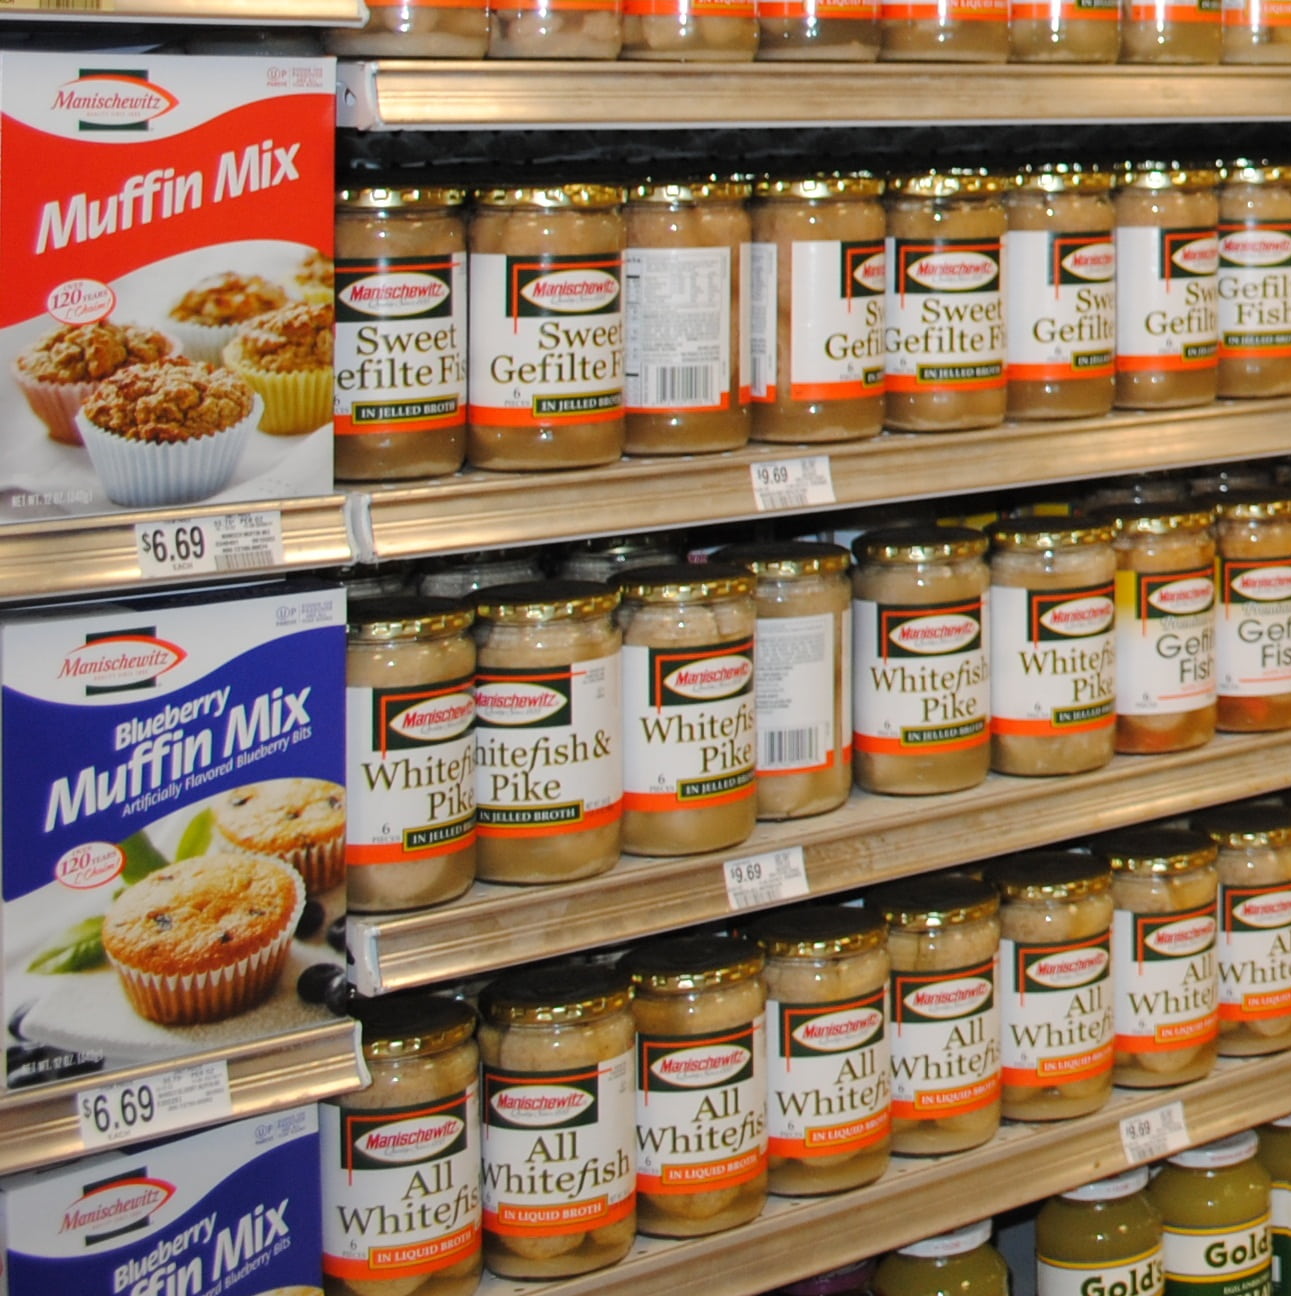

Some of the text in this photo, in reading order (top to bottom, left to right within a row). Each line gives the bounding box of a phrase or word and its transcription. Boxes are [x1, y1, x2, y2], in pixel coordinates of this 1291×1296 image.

[50, 90, 163, 113] Manischewitz
[35, 138, 302, 256] Muffin Mix
[52, 288, 82, 310] 120
[350, 282, 445, 301] Manischewitz
[532, 278, 616, 296] Manischewitz
[921, 297, 1003, 325] Sweet
[356, 323, 458, 357] Sweet
[538, 320, 624, 351] Sweet
[886, 326, 985, 355] Gefilte
[334, 356, 431, 392] efilte
[490, 352, 609, 385] Gefilte
[361, 399, 456, 418] IN JELLED BROTH
[541, 396, 598, 412] IN JELLED
[757, 465, 789, 486] $9.69
[141, 526, 206, 564] $6.69
[57, 650, 170, 678] Manischewitz
[1071, 671, 1115, 703] Pike
[114, 686, 232, 751] Blueberry
[921, 695, 978, 724] Pike
[43, 686, 313, 833] Muffin Mix
[121, 726, 313, 819] Artificially Flavored Blueberry Bits
[700, 739, 753, 776] Pike
[427, 783, 475, 822] Pike
[490, 771, 562, 803] Pike
[686, 782, 700, 795] IN
[492, 808, 533, 825] JELLED
[534, 806, 577, 822] BROTH
[412, 832, 426, 845] IN
[60, 852, 92, 877] 120
[731, 862, 762, 884] $9.69
[1182, 958, 1214, 987] All
[1066, 988, 1102, 1019] All
[943, 1018, 984, 1052] All
[661, 1049, 744, 1073] Manischewitz
[834, 1050, 877, 1085] All
[83, 1083, 155, 1133] $6.69
[497, 1092, 587, 1111] Manischewitz
[691, 1088, 741, 1124] All
[922, 1093, 934, 1104] IN
[366, 1120, 459, 1151] Manischewitz
[526, 1131, 578, 1163] All
[812, 1123, 861, 1142] IN LIQUID
[402, 1160, 454, 1200] All
[482, 1148, 630, 1198] Whitefish
[669, 1168, 682, 1180] IN
[684, 1163, 723, 1180] LIQUID
[58, 1188, 161, 1236] Manischewitz
[505, 1202, 603, 1223] IN LIQUID BROTH
[113, 1211, 219, 1295] Blueberry
[212, 1198, 290, 1282] Mix
[377, 1230, 473, 1263] IN LIQUID BROTH
[1204, 1225, 1271, 1269] Gold
[225, 1237, 292, 1288] Blueberry Bits
